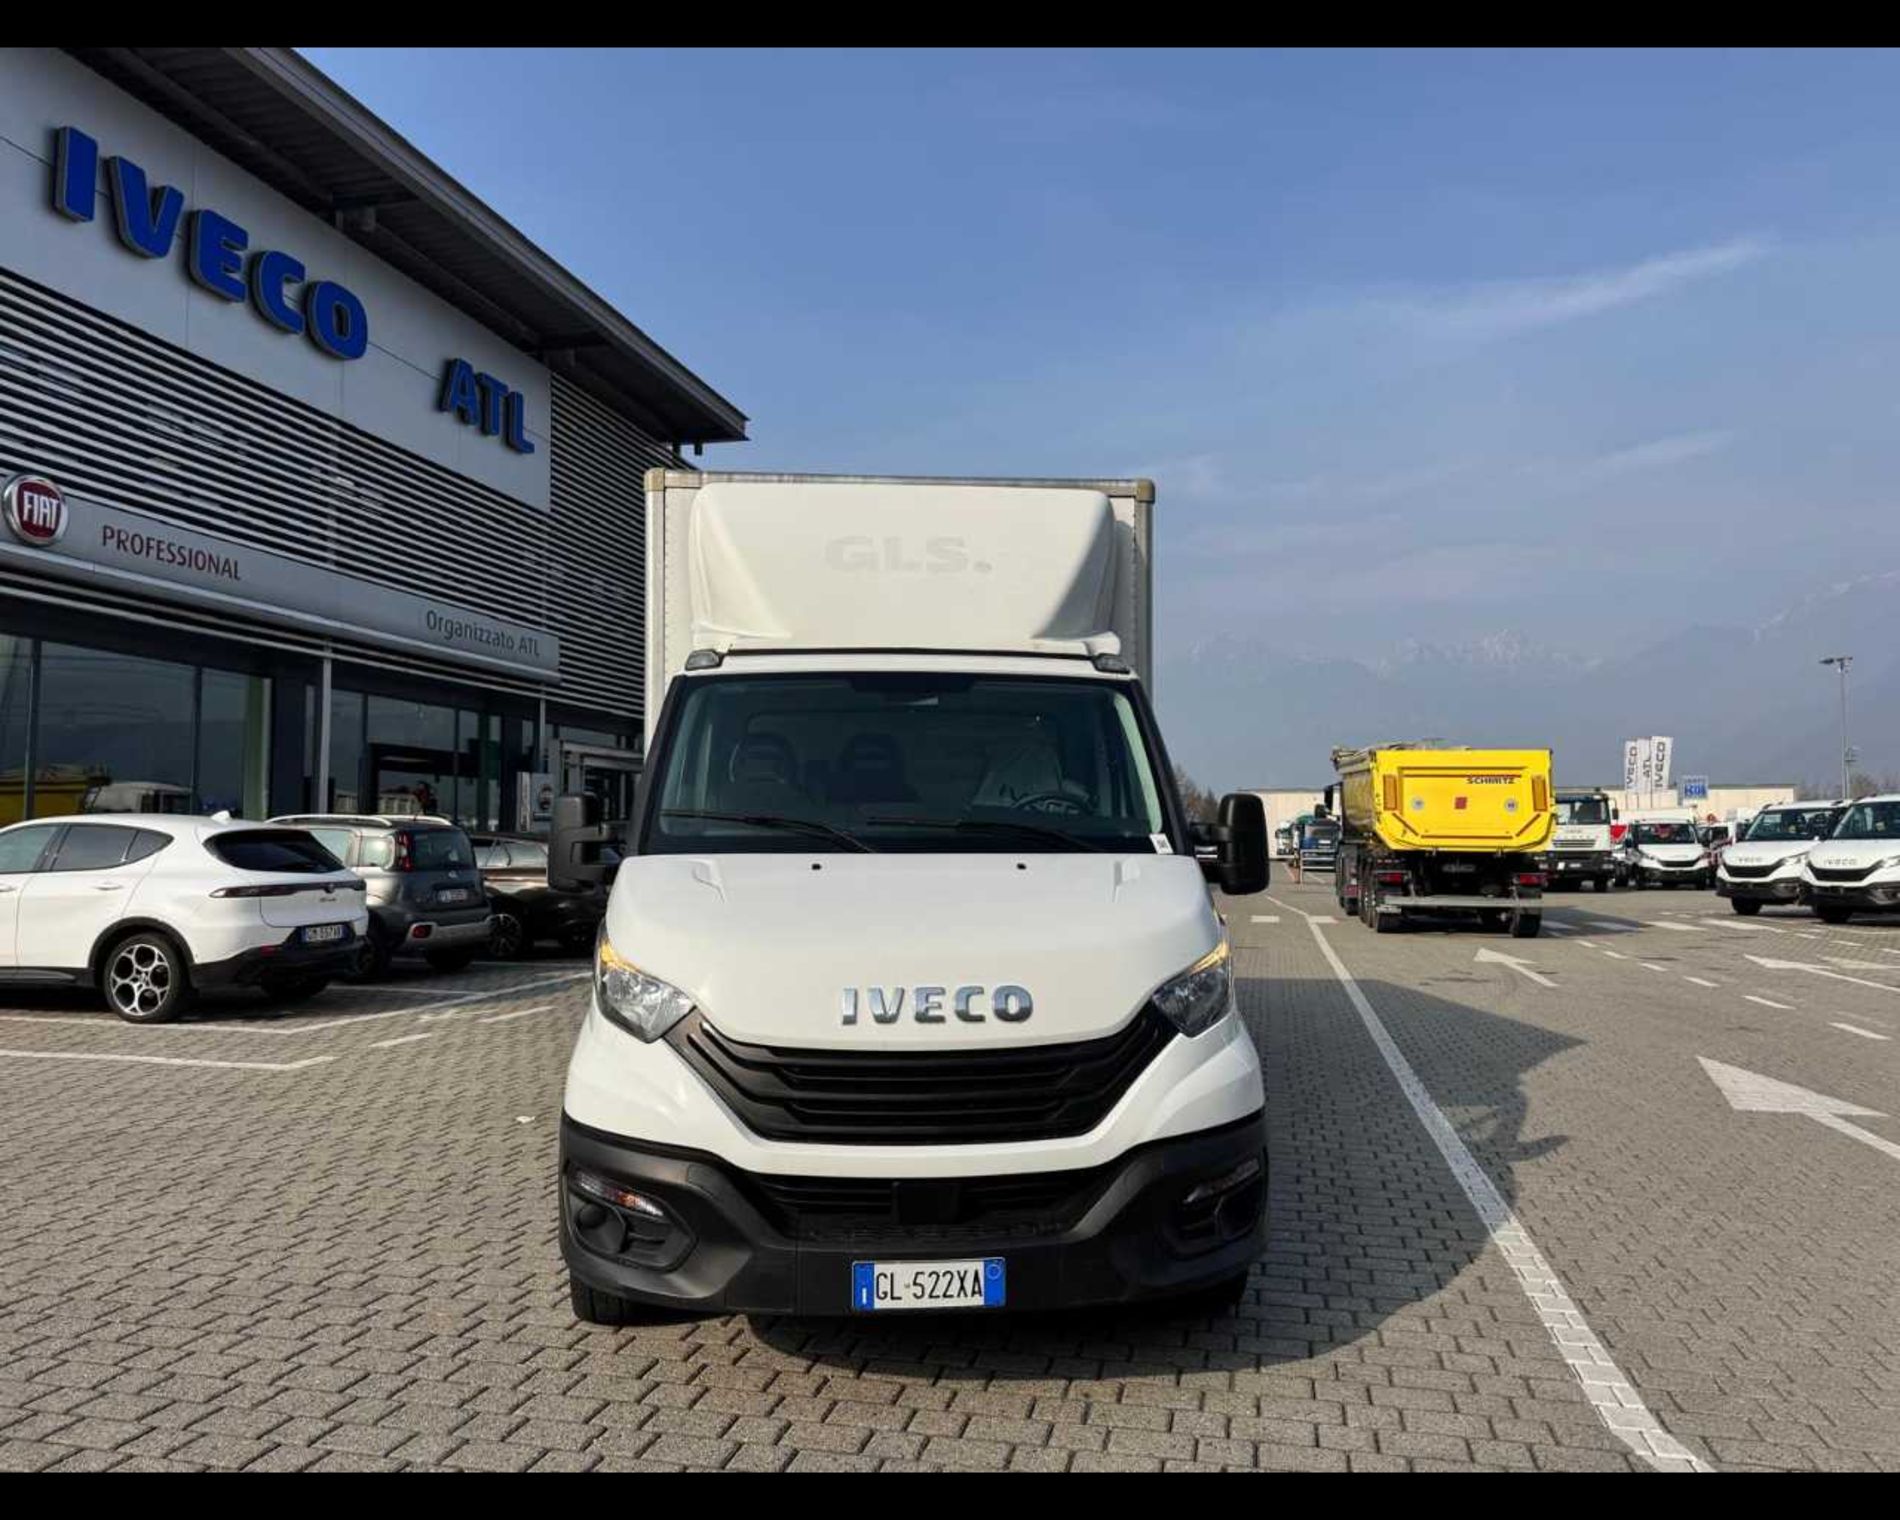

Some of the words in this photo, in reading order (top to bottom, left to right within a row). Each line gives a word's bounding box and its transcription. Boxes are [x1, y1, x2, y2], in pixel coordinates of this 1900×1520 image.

[55, 125, 369, 360] IVECO
[440, 358, 535, 454] ATL
[22, 490, 60, 531] FIAT
[102, 524, 241, 582] PROFESSIONAL
[426, 609, 515, 651] Organizzato
[518, 635, 540, 657] ATL
[1466, 776, 1515, 785] SCHMITZ
[1654, 741, 1666, 788] IVECO
[841, 984, 1034, 1026] IVECO
